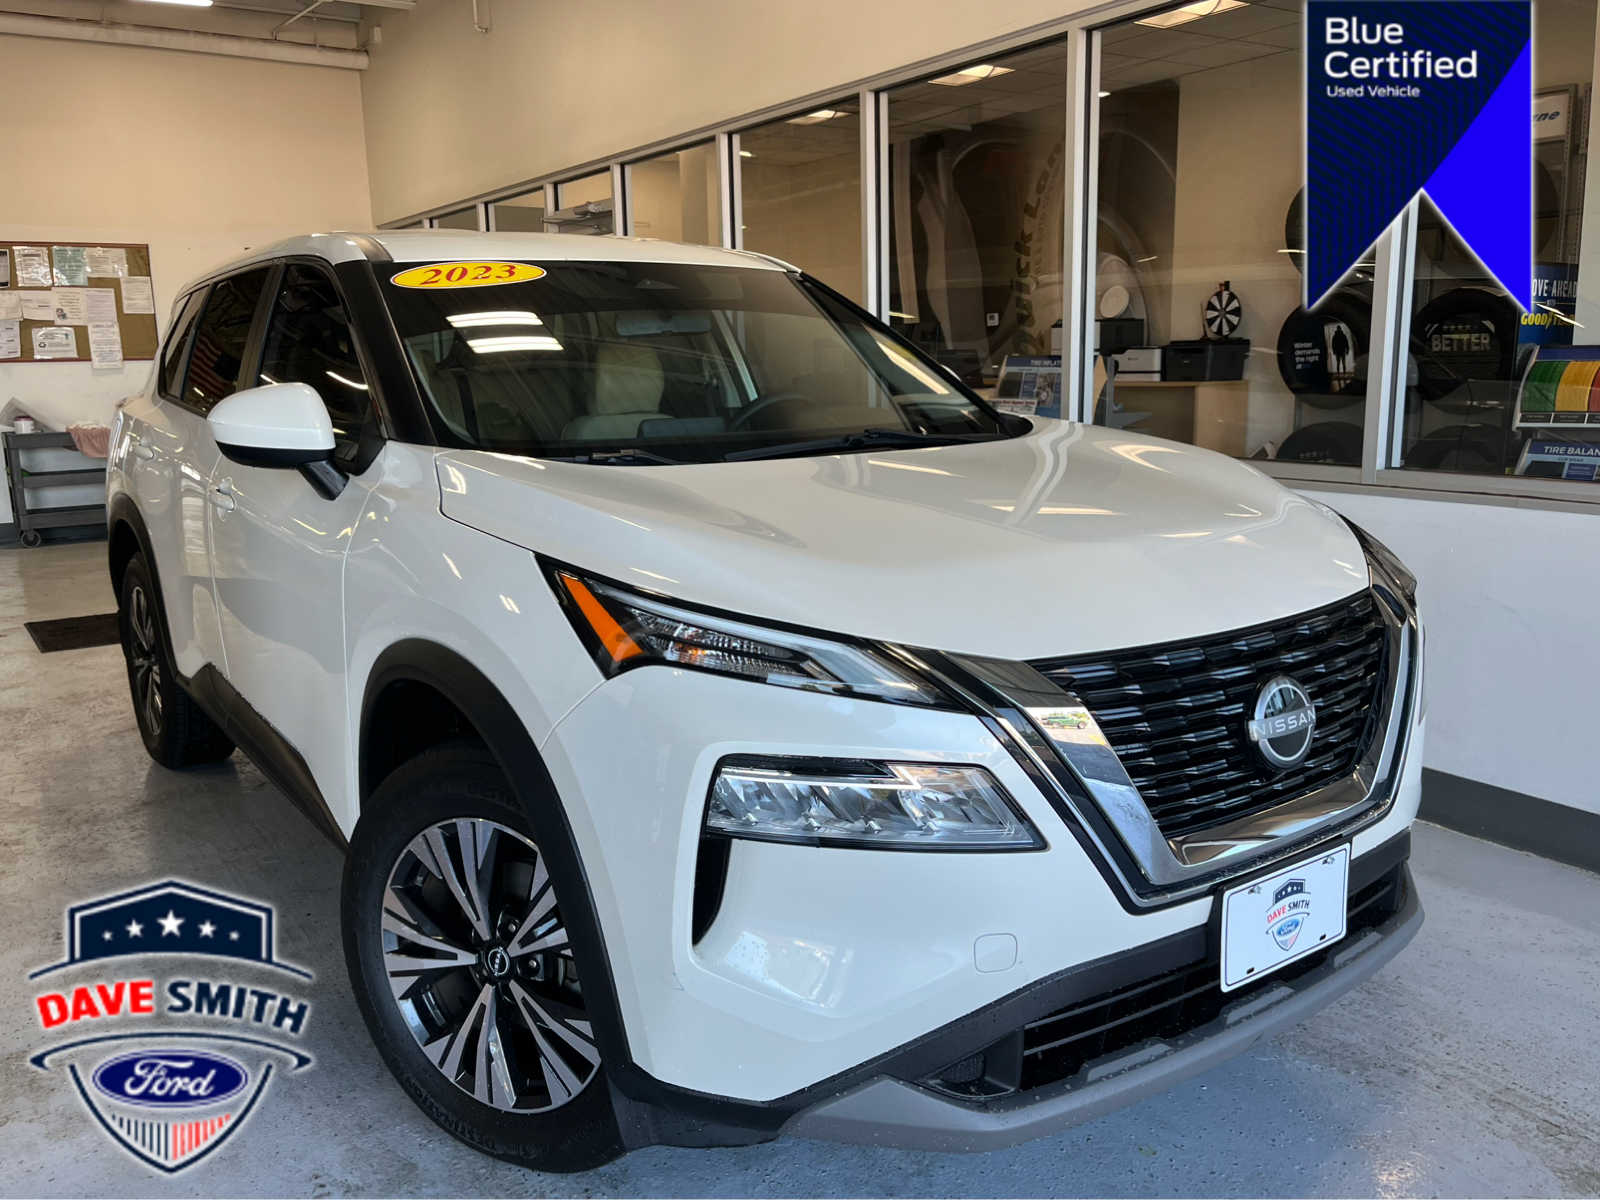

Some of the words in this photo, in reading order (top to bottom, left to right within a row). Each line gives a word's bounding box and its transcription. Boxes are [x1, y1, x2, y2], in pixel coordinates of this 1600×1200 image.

[1533, 110, 1561, 122] ne
[419, 264, 517, 286] 2023
[1520, 312, 1576, 326] GOODY
[1431, 333, 1491, 353] BETTER
[1543, 446, 1566, 455] TIRE
[1250, 708, 1316, 741] NISSAN
[1266, 904, 1287, 924] DAVE
[1287, 899, 1311, 912] SMITH
